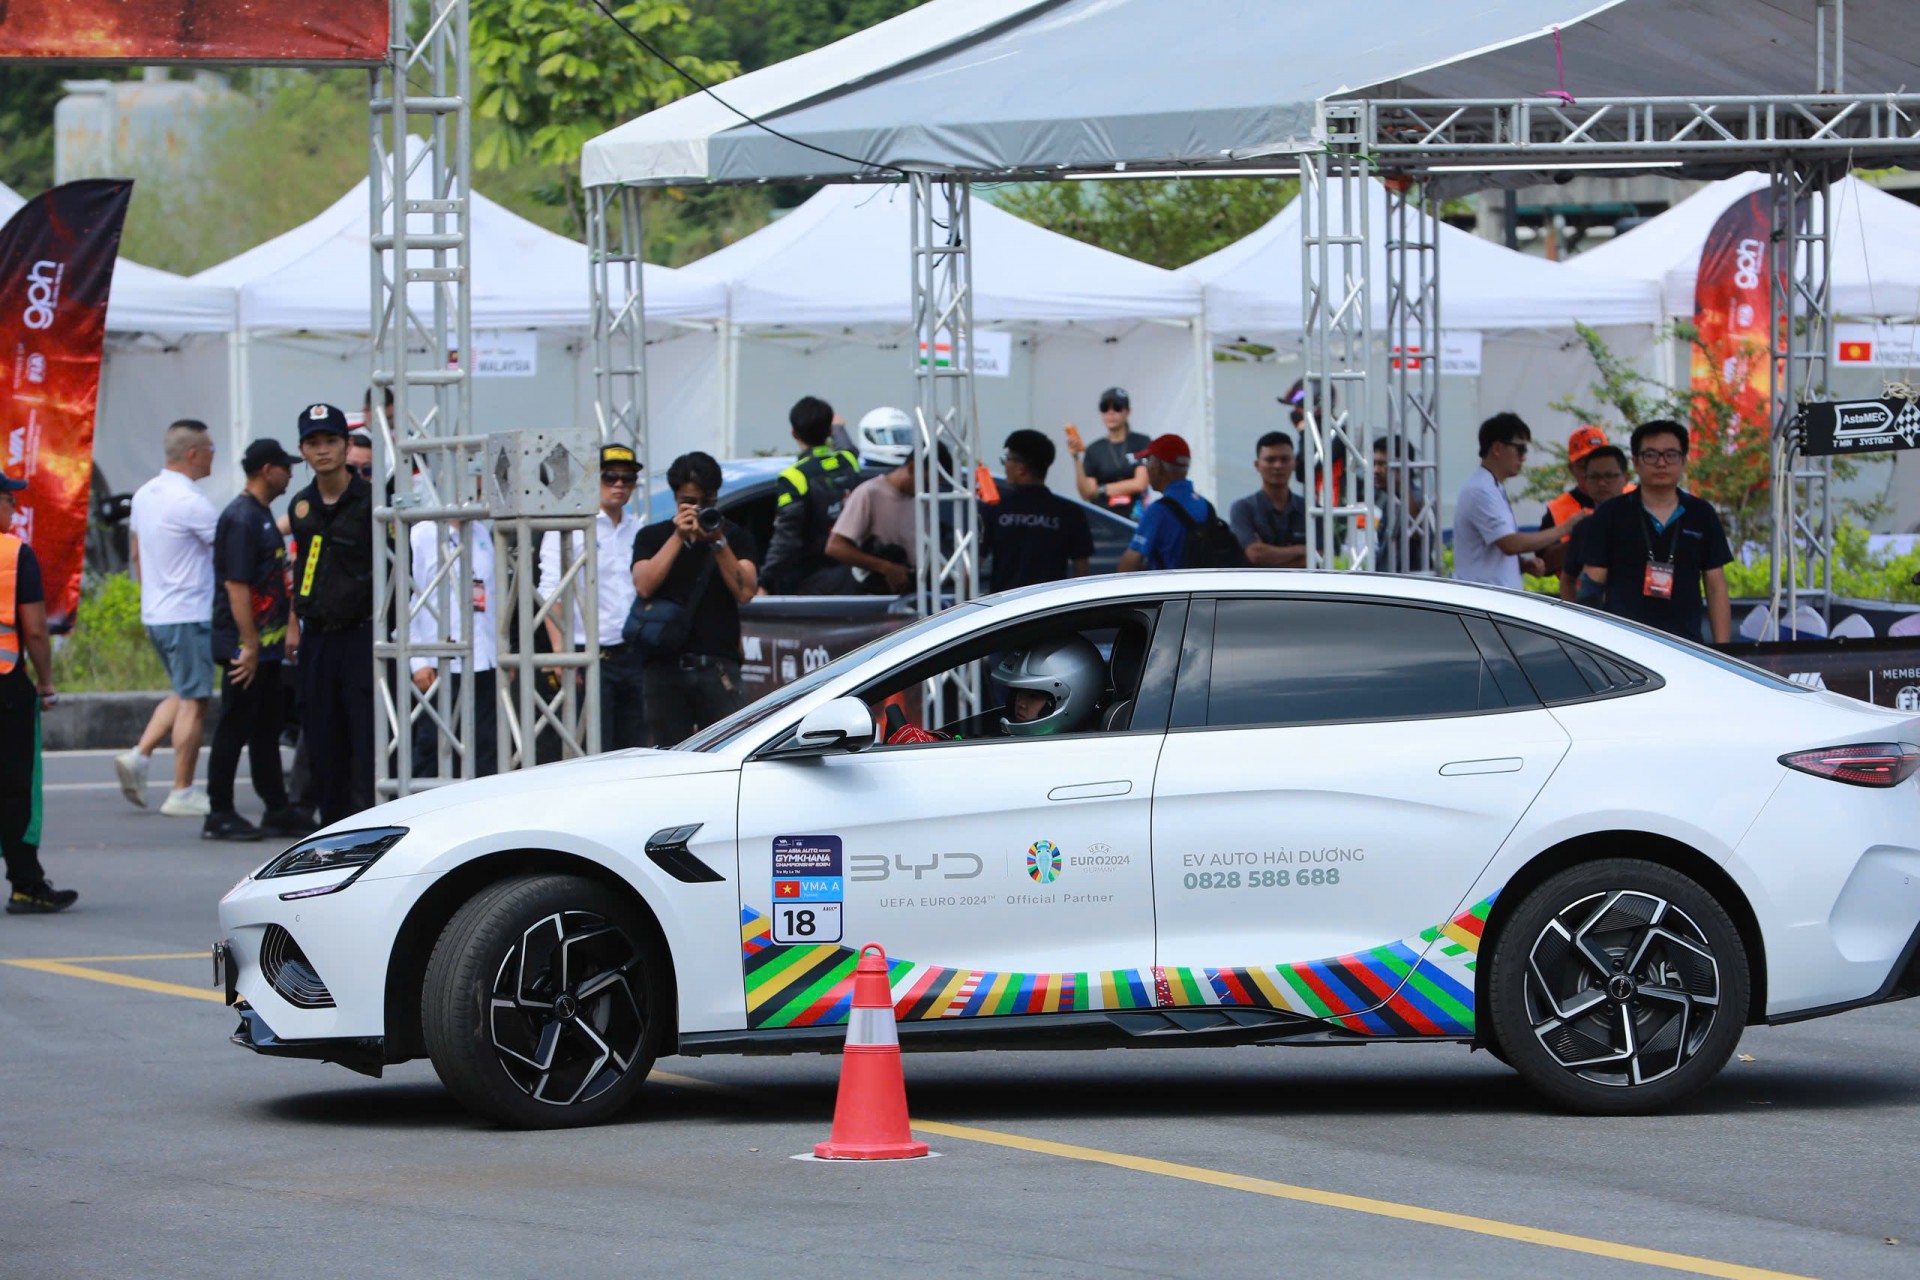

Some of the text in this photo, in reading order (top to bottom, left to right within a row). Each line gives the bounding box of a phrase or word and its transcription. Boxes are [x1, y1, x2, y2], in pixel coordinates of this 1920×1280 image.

[1842, 412, 1886, 424] AstaMEC
[999, 513, 1059, 529] OFFICIALS
[1089, 845, 1110, 853] UEFA
[776, 854, 830, 862] GYMKHANA
[1183, 847, 1365, 867] EV AUTO HẢI DƯƠNG
[850, 853, 984, 882] BYD
[802, 881, 840, 890] VMA A
[1183, 868, 1340, 889] 0828 588 688
[880, 896, 915, 908] UEFA
[920, 896, 955, 907] EURO
[1006, 893, 1055, 905] Official
[1064, 893, 1114, 903] Partner
[783, 910, 816, 936] 18
